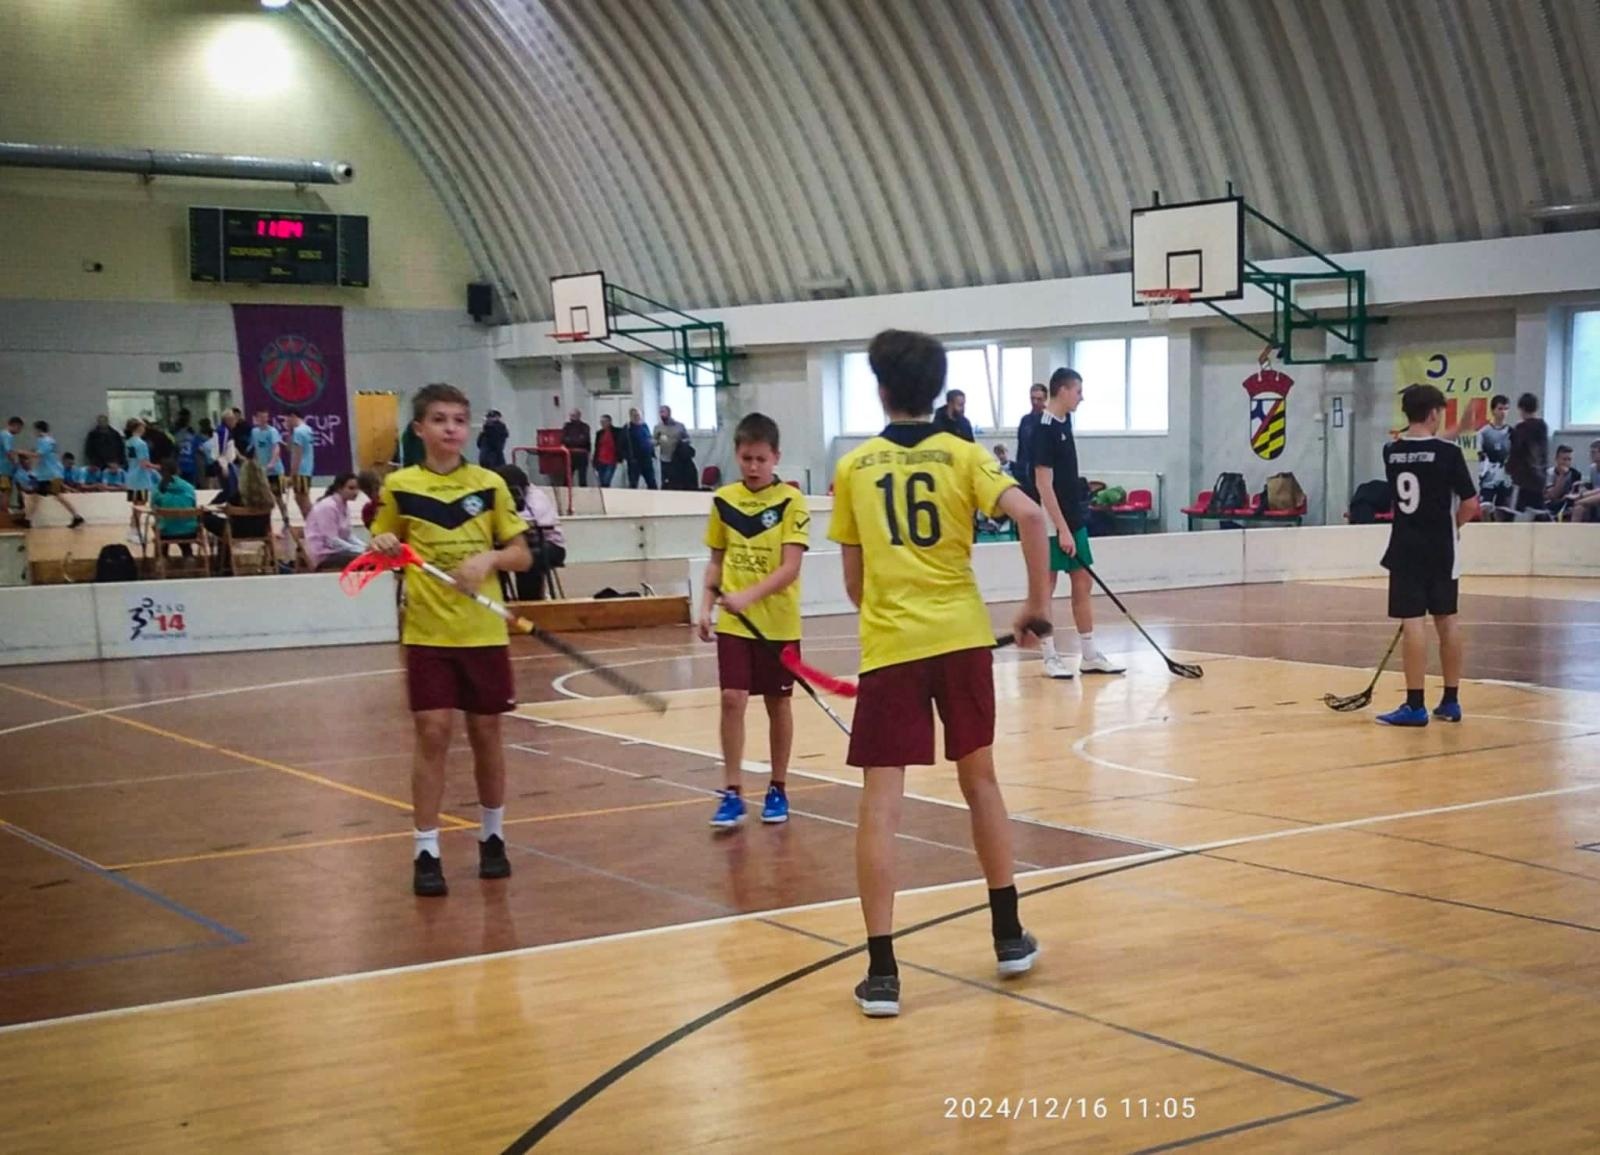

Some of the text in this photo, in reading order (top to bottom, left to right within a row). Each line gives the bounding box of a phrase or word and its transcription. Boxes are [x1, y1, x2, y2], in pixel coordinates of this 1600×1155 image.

[875, 471, 942, 547] 16
[1396, 471, 1421, 514] 9
[154, 614, 186, 632] 14
